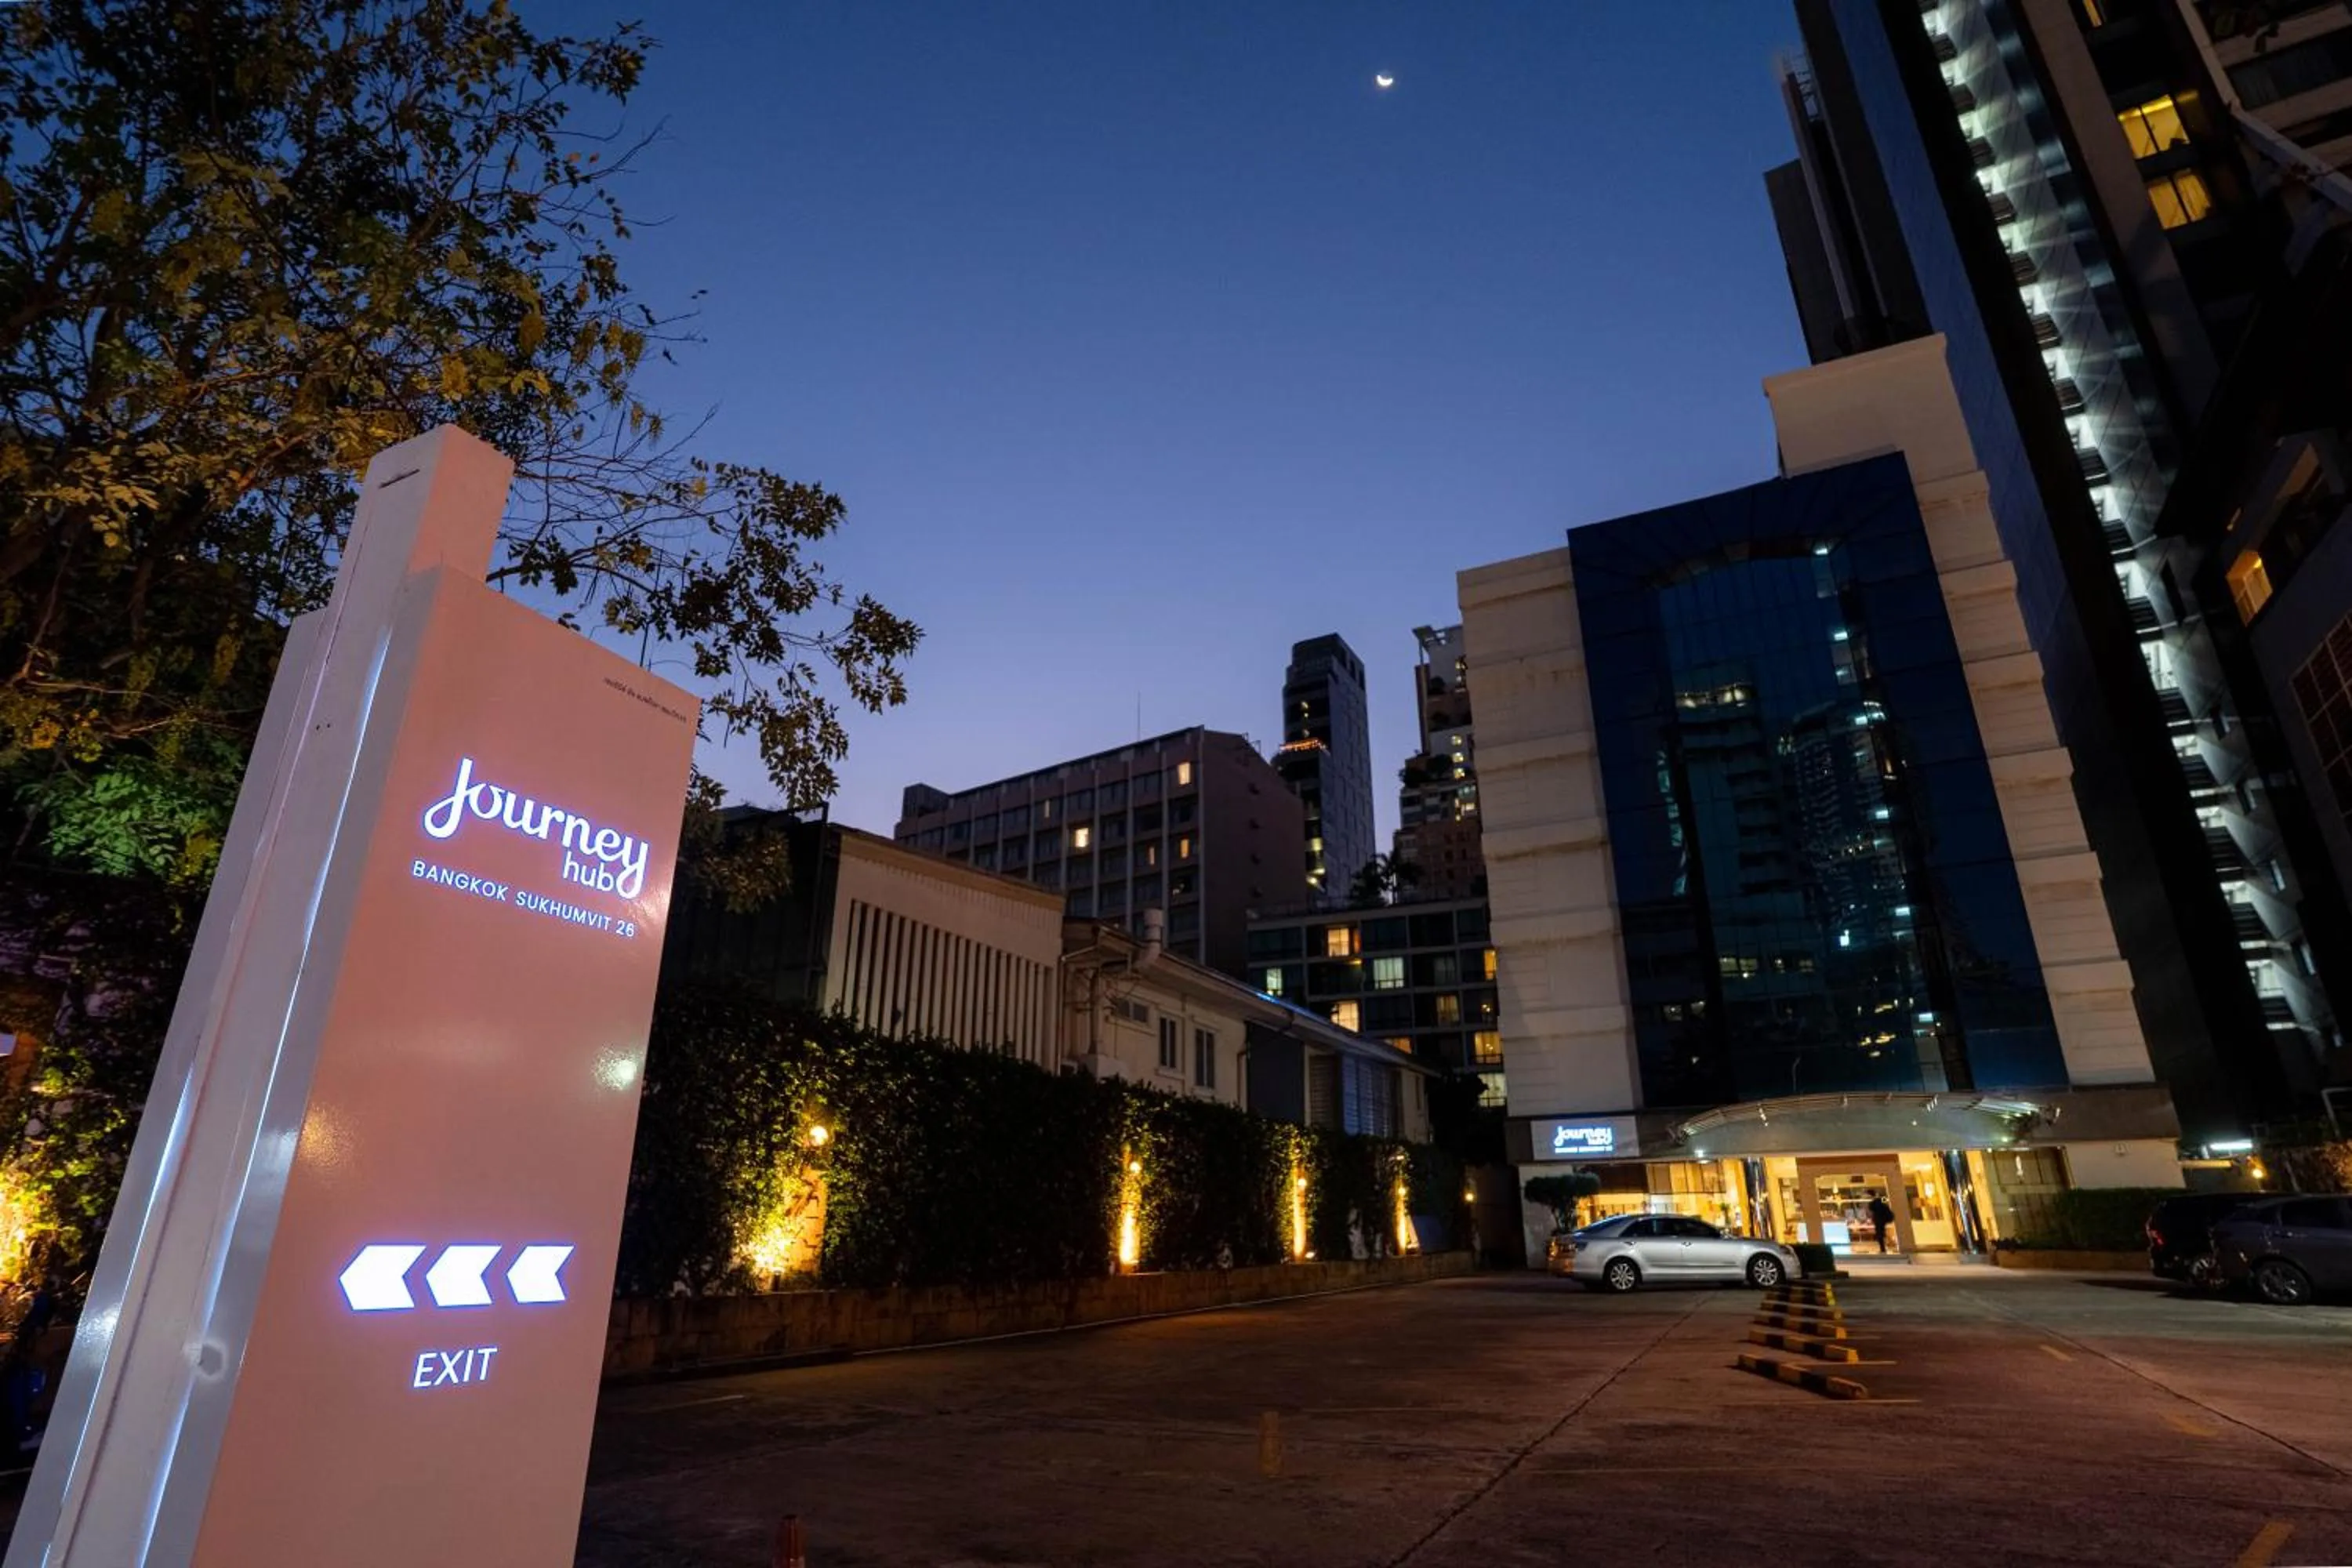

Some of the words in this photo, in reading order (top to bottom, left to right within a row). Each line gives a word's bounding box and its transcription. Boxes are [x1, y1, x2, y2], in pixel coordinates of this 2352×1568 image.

[424, 758, 649, 899] Journey
[412, 860, 509, 902] BANGKOK
[515, 891, 613, 932] SUKHUMVIT
[615, 920, 635, 938] 26
[562, 851, 615, 892] hub
[413, 1347, 498, 1388] EXIT
